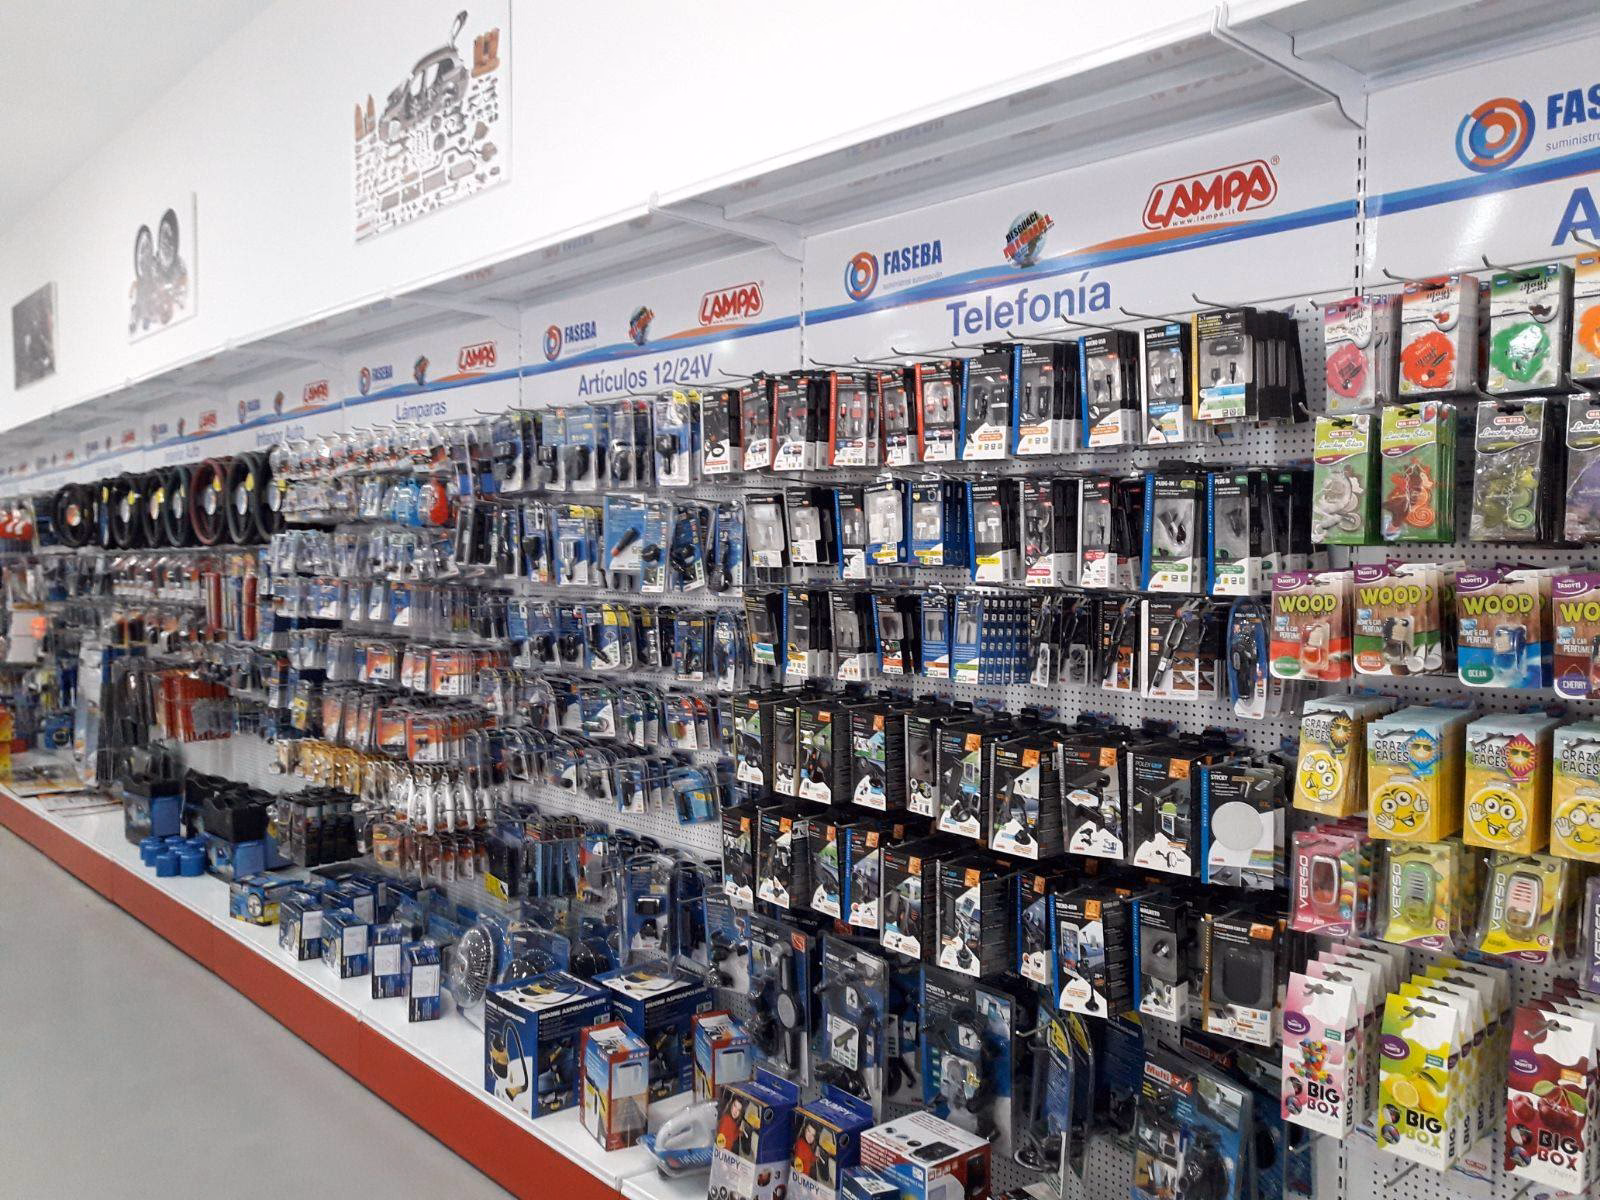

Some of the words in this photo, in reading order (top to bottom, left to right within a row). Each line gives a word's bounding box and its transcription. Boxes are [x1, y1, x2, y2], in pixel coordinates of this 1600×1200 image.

[1147, 164, 1274, 228] LAMPA
[883, 240, 943, 275] FASEBA
[701, 284, 761, 325] LAMPA
[946, 271, 1112, 337] Telefonía
[564, 320, 597, 344] FASEBA
[578, 368, 647, 397] Artículos
[653, 353, 713, 386] 12/24V
[395, 400, 447, 421] Lámparas
[1278, 594, 1337, 612] WOOD
[1360, 585, 1422, 606] WOOD
[1462, 594, 1535, 615] WOOD
[1560, 601, 1600, 623] WO
[1562, 680, 1587, 689] CHERRY
[1304, 718, 1331, 731] CRAZY
[1304, 728, 1330, 741] FACES
[1374, 740, 1408, 751] CRAZY
[1473, 744, 1507, 756] CRAZY
[1562, 749, 1600, 761] CRAZY
[1376, 751, 1410, 763] FACES
[1474, 754, 1508, 768] FACES
[1562, 760, 1600, 775] FACES
[1299, 855, 1309, 909] VERSO
[1391, 863, 1402, 919] VERSO
[1491, 873, 1506, 930] VERSO
[1308, 1081, 1340, 1104] BIG
[1307, 1098, 1339, 1119] BOX
[1406, 1109, 1442, 1134] BIG
[1406, 1128, 1441, 1149] BOX
[1538, 1129, 1579, 1155] BIG
[714, 1149, 742, 1172] DUMPY
[1538, 1148, 1577, 1171] BOX
[791, 1170, 821, 1196] DUMPY
